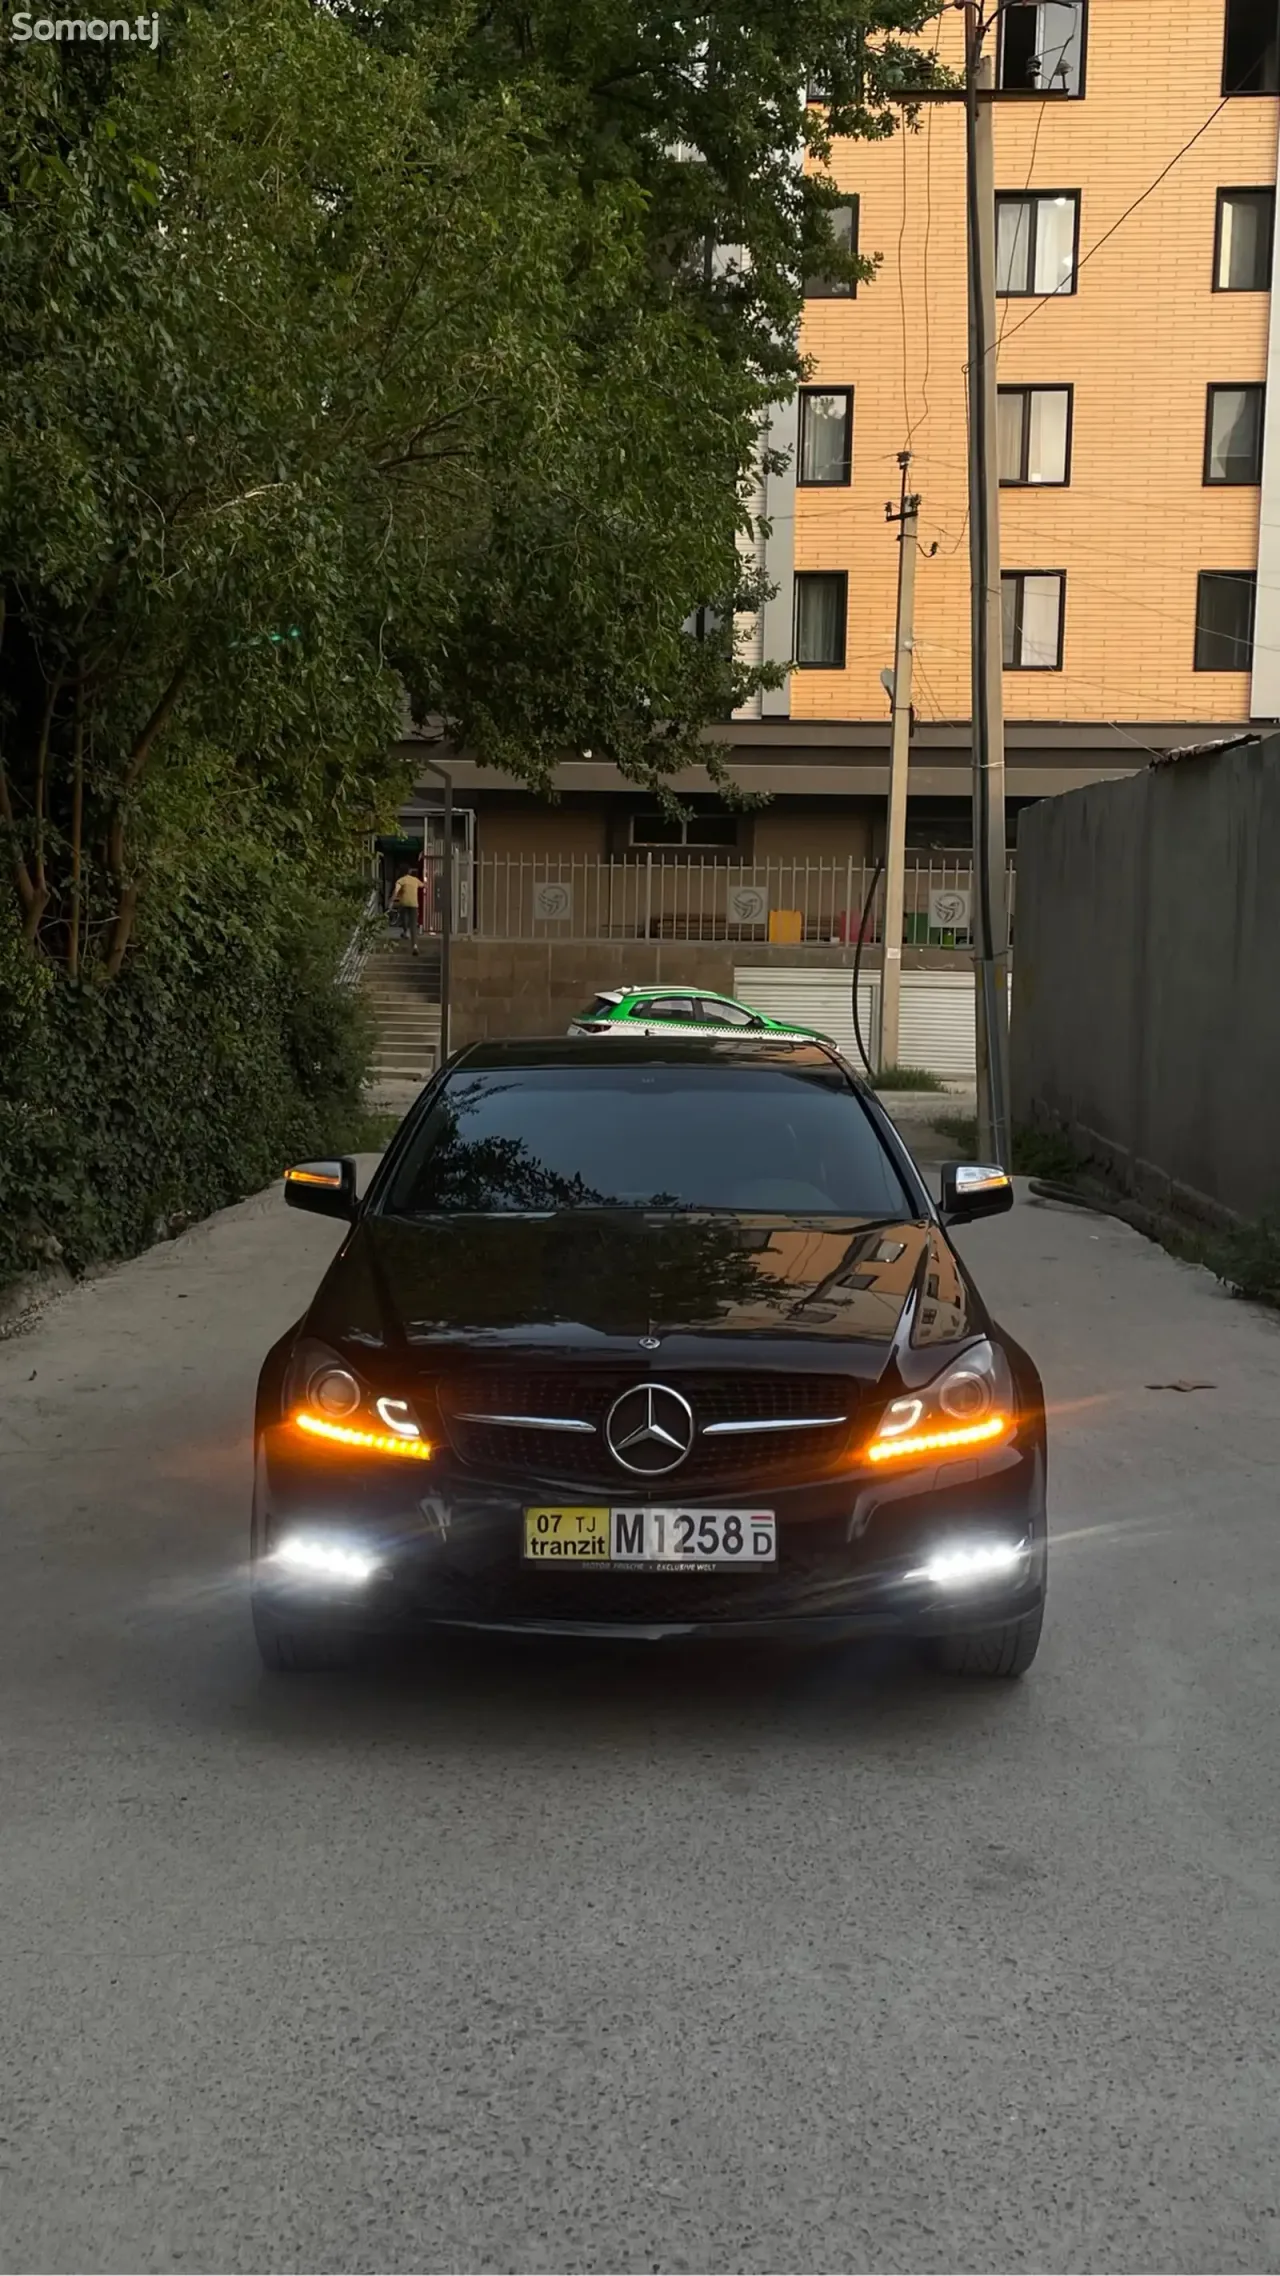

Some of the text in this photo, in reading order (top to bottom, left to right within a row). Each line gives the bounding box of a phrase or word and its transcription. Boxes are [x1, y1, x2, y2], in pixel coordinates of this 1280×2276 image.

[537, 1515, 596, 1533] 07 TJ
[616, 1514, 772, 1555] M1258 D
[531, 1536, 605, 1556] tranzit
[656, 1563, 695, 1572] EXCLUSIVE
[697, 1563, 717, 1572] WELT
